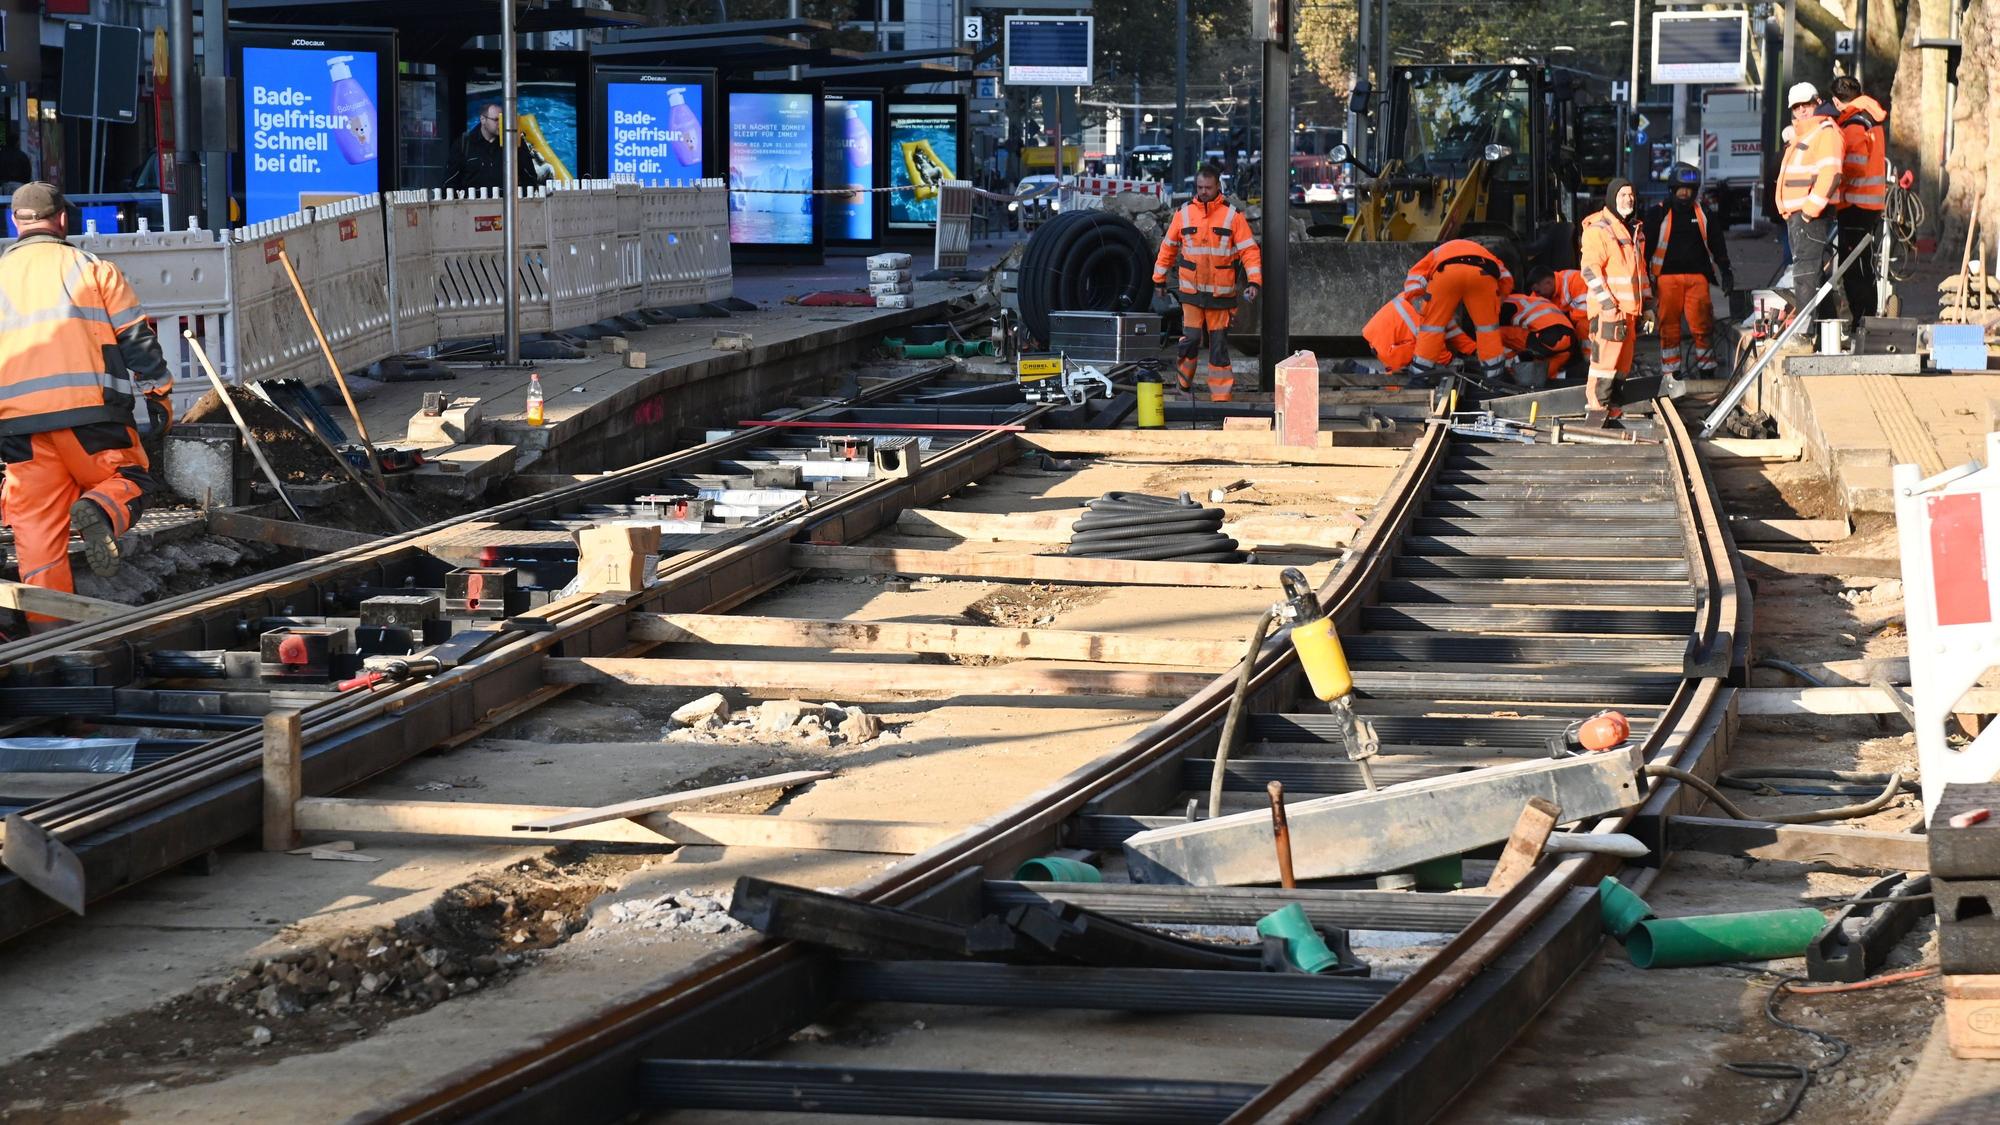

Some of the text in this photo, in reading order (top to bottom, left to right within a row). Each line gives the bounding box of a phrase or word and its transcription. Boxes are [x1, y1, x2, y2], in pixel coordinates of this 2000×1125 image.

[967, 23, 978, 38] 3
[1838, 38, 1850, 52] 4
[253, 86, 312, 106] Bade-
[1611, 81, 1629, 102] H
[253, 109, 352, 131] Igelfrisur.
[614, 110, 656, 125] Bade-
[254, 131, 328, 151] Schnell
[614, 127, 684, 144] Igelfrisur.
[614, 143, 667, 157] Schnell
[254, 153, 321, 173] bei dir.
[614, 159, 662, 173] bei dir.
